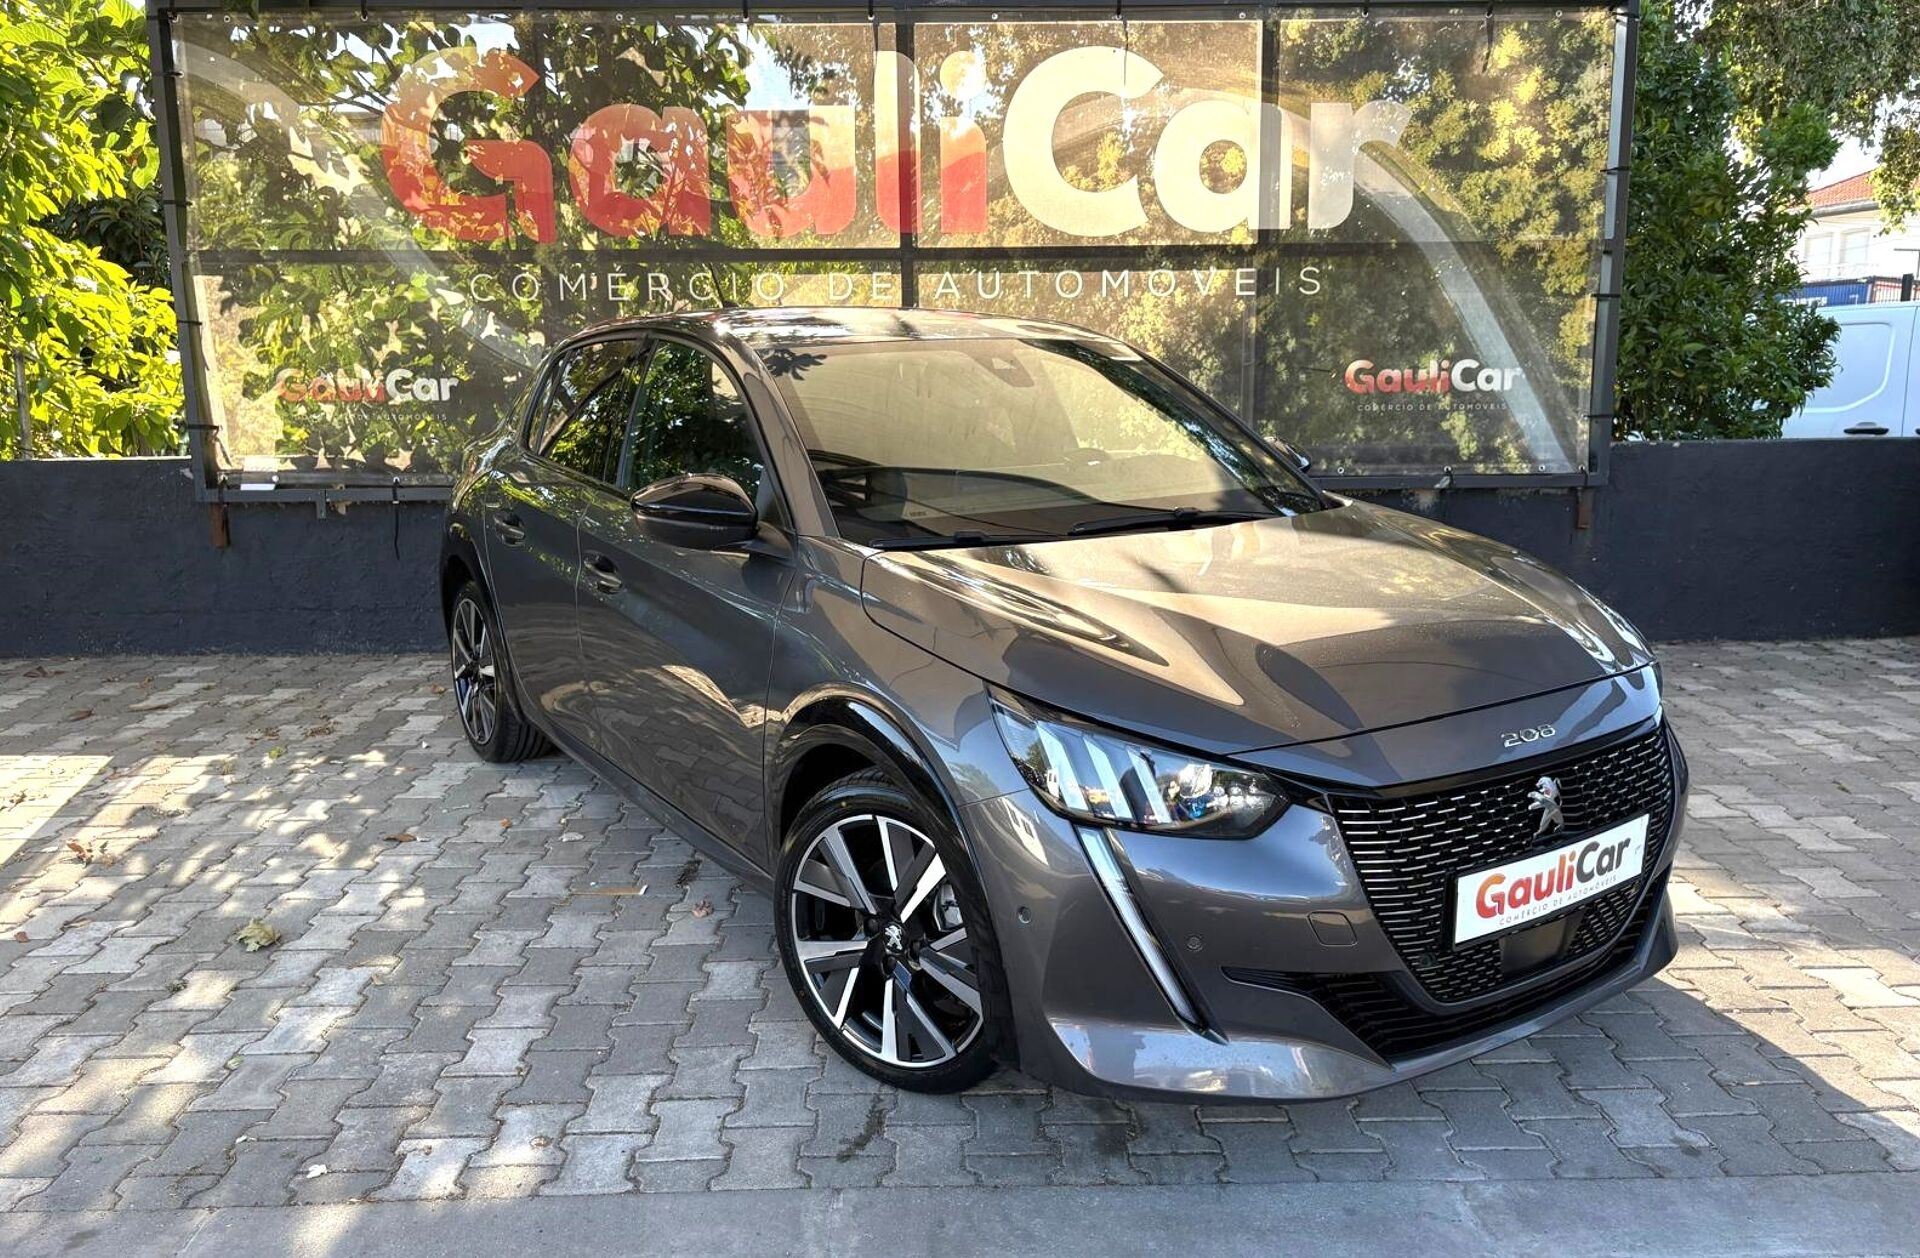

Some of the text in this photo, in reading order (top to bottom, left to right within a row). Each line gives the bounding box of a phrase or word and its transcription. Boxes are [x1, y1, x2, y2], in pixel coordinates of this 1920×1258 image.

[381, 46, 1411, 244] GauliCar
[828, 271, 893, 301] DE
[276, 368, 459, 403] GauliCar
[1344, 359, 1521, 394] GauliCar
[1418, 403, 1433, 411] DE
[1501, 723, 1556, 748] 208
[1475, 837, 1631, 919] GauliCar
[1553, 898, 1564, 907] DE
